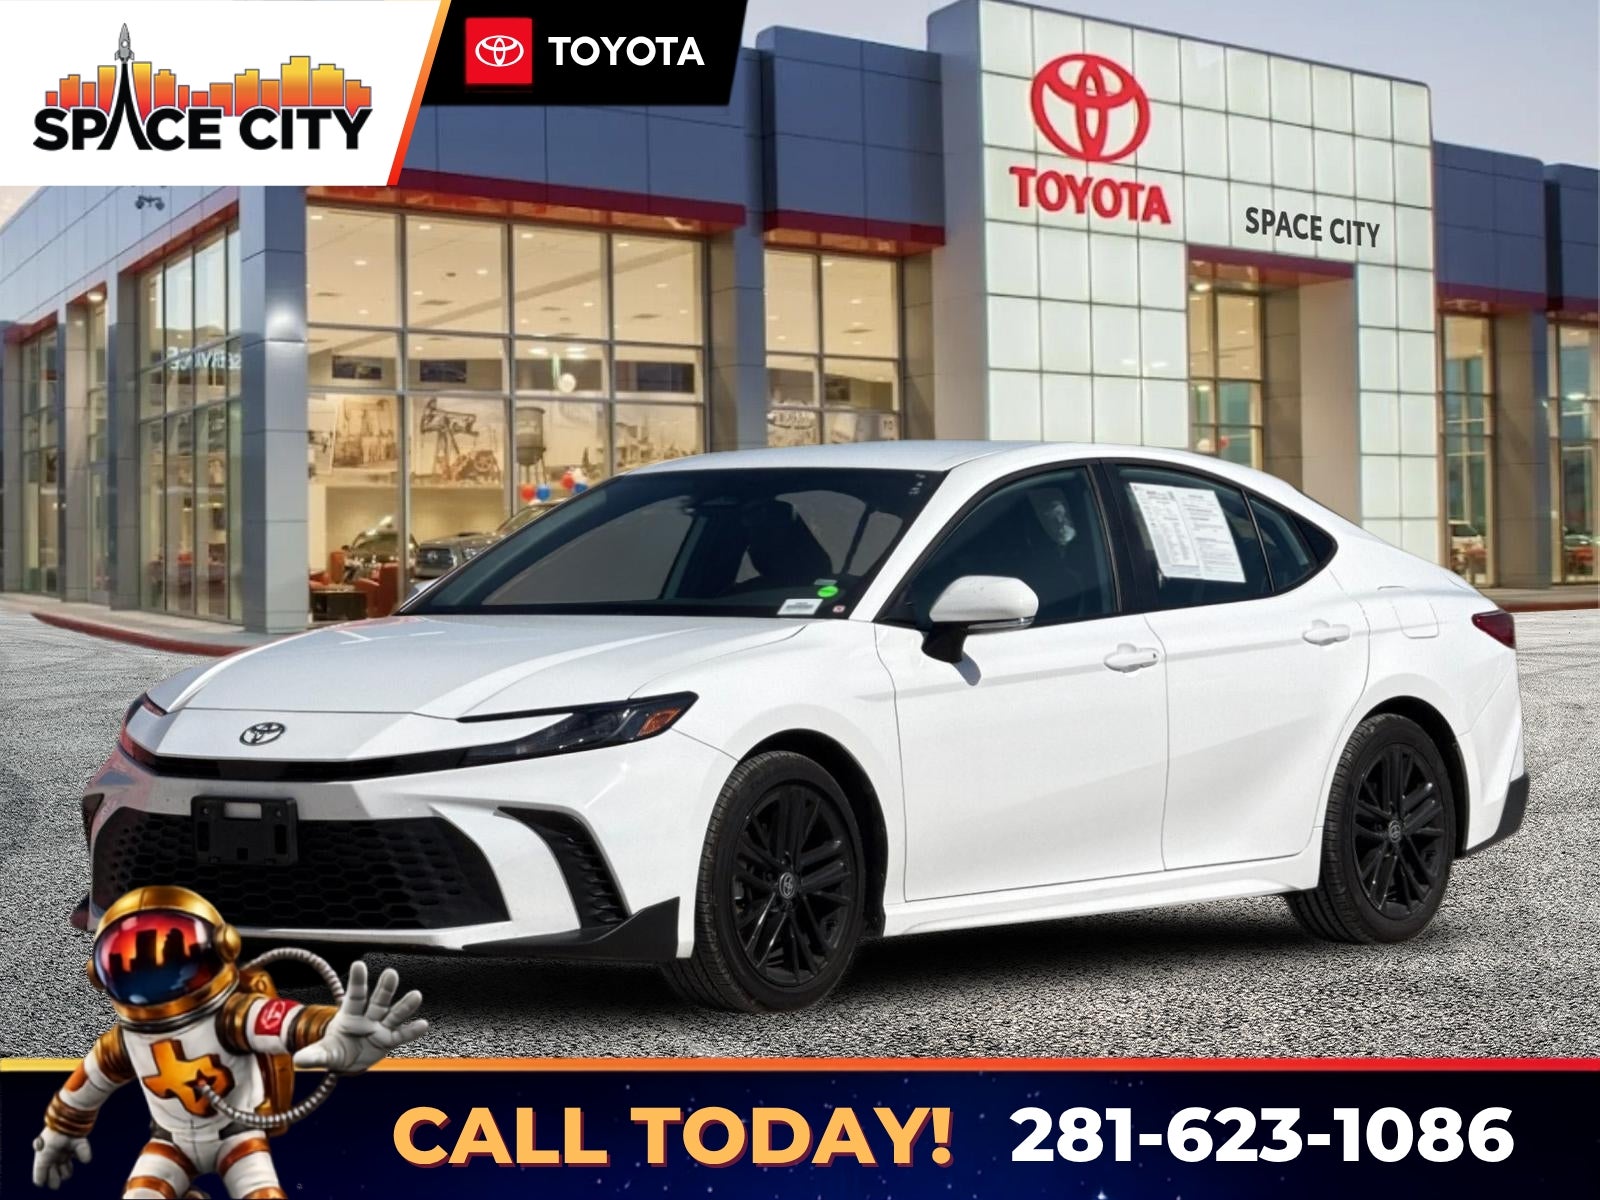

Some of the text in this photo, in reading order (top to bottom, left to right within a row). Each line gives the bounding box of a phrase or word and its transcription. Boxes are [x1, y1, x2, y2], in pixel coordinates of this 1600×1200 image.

[1009, 166, 1171, 225] TOYOTA
[1245, 206, 1381, 248] SPACE CITY
